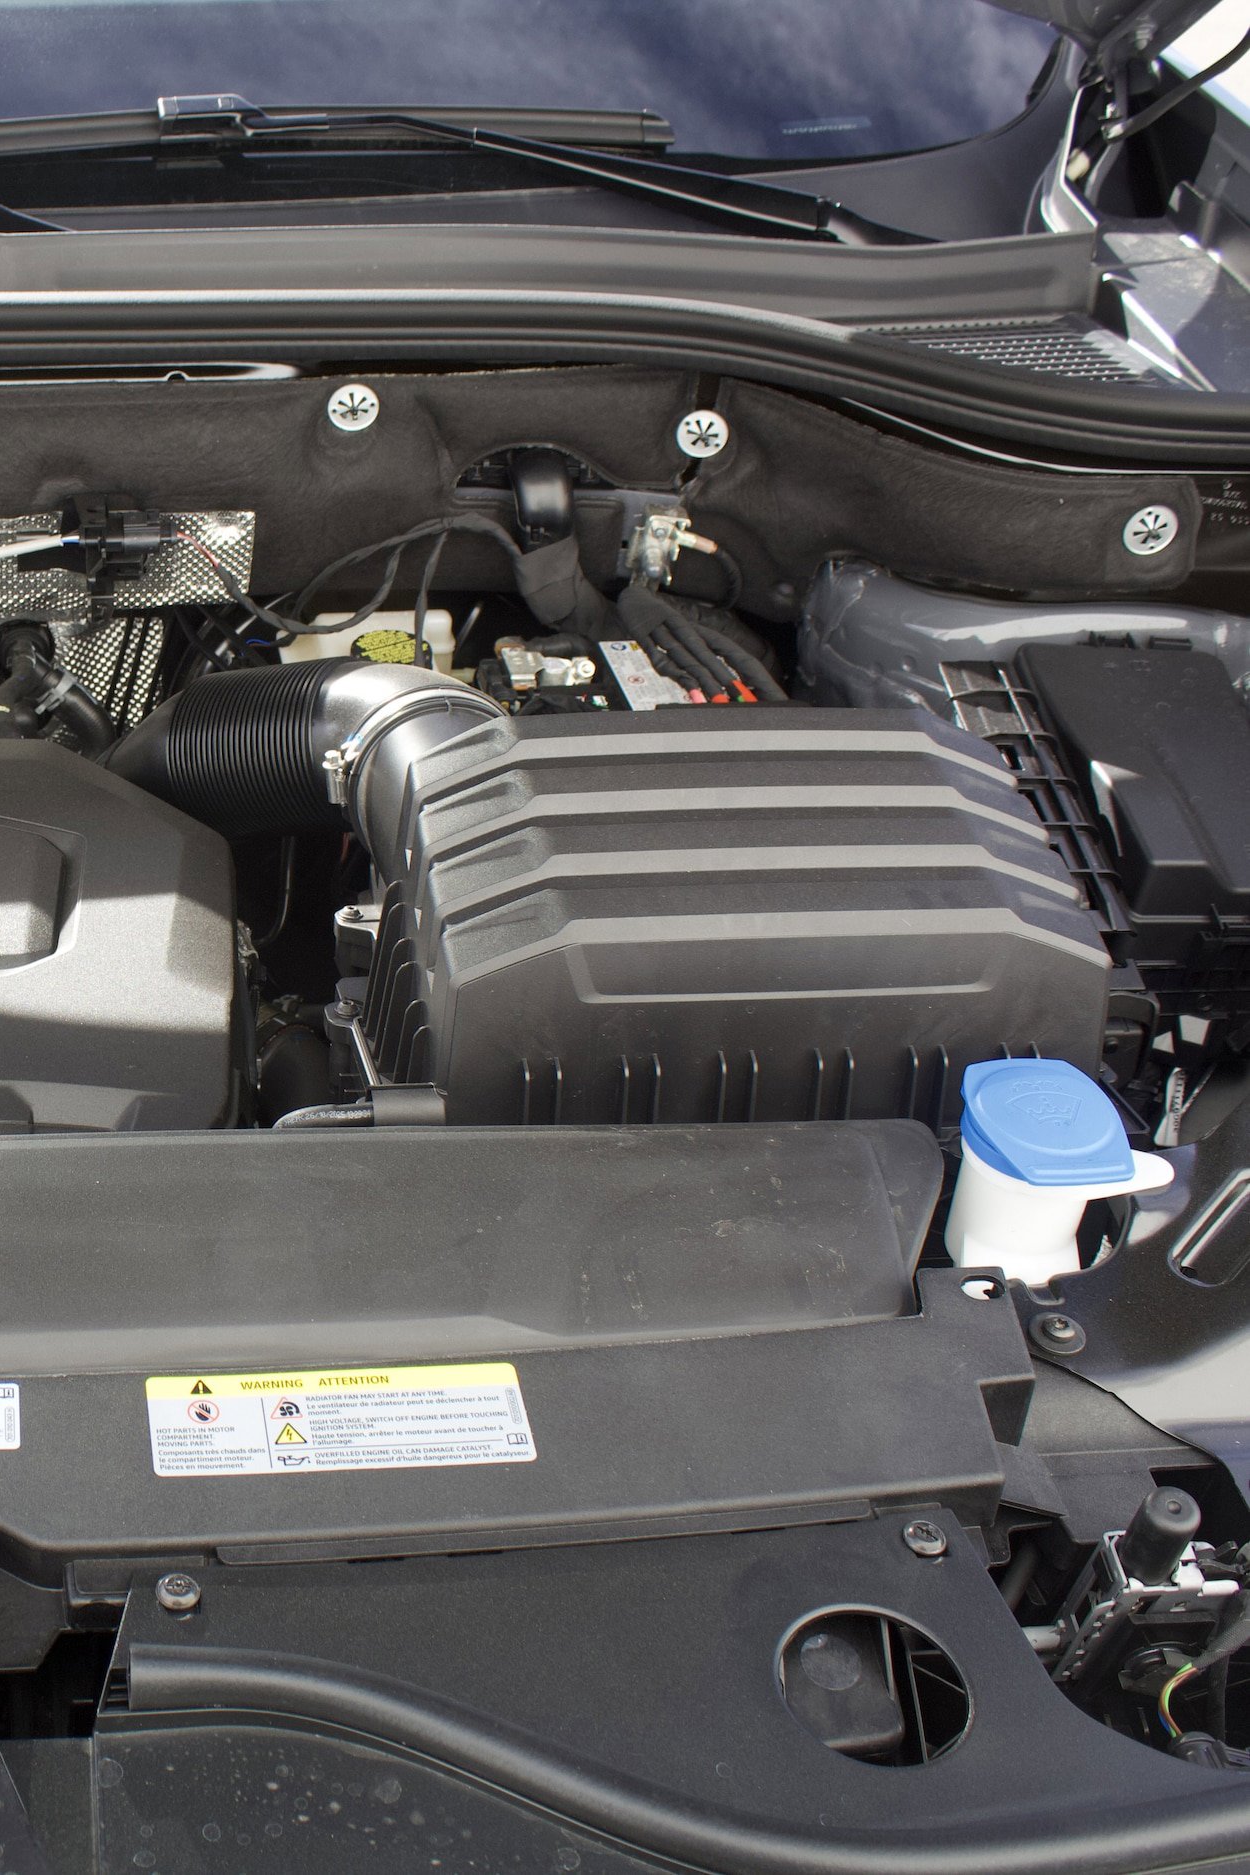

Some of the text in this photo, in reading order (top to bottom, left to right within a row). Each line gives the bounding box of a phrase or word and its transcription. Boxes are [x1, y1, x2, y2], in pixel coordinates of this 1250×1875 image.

[240, 1375, 389, 1390] WARNING ATTENTION
[315, 1450, 361, 1458] OVERFILLED
[316, 1458, 363, 1466] Remplissage
